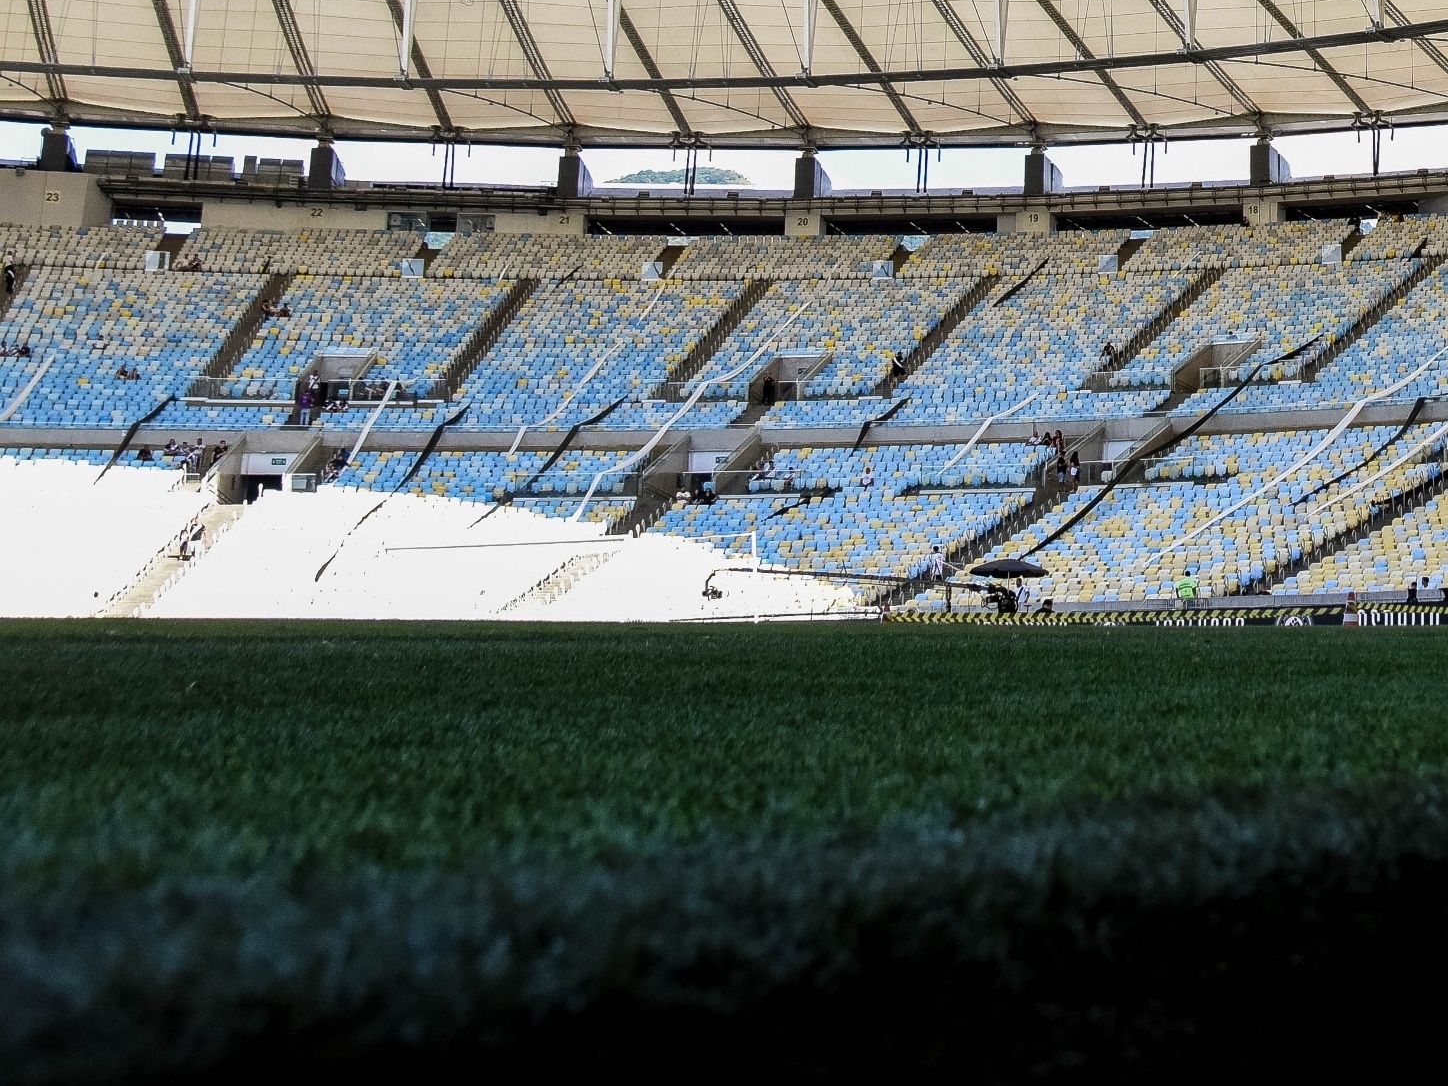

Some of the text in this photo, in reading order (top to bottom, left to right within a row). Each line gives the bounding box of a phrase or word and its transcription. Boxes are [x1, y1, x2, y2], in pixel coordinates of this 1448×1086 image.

[45, 192, 60, 202] 23
[310, 207, 323, 217] 22
[1248, 205, 1259, 214] 18
[559, 215, 570, 224] 21
[797, 217, 809, 226] 20
[1028, 213, 1039, 223] 19
